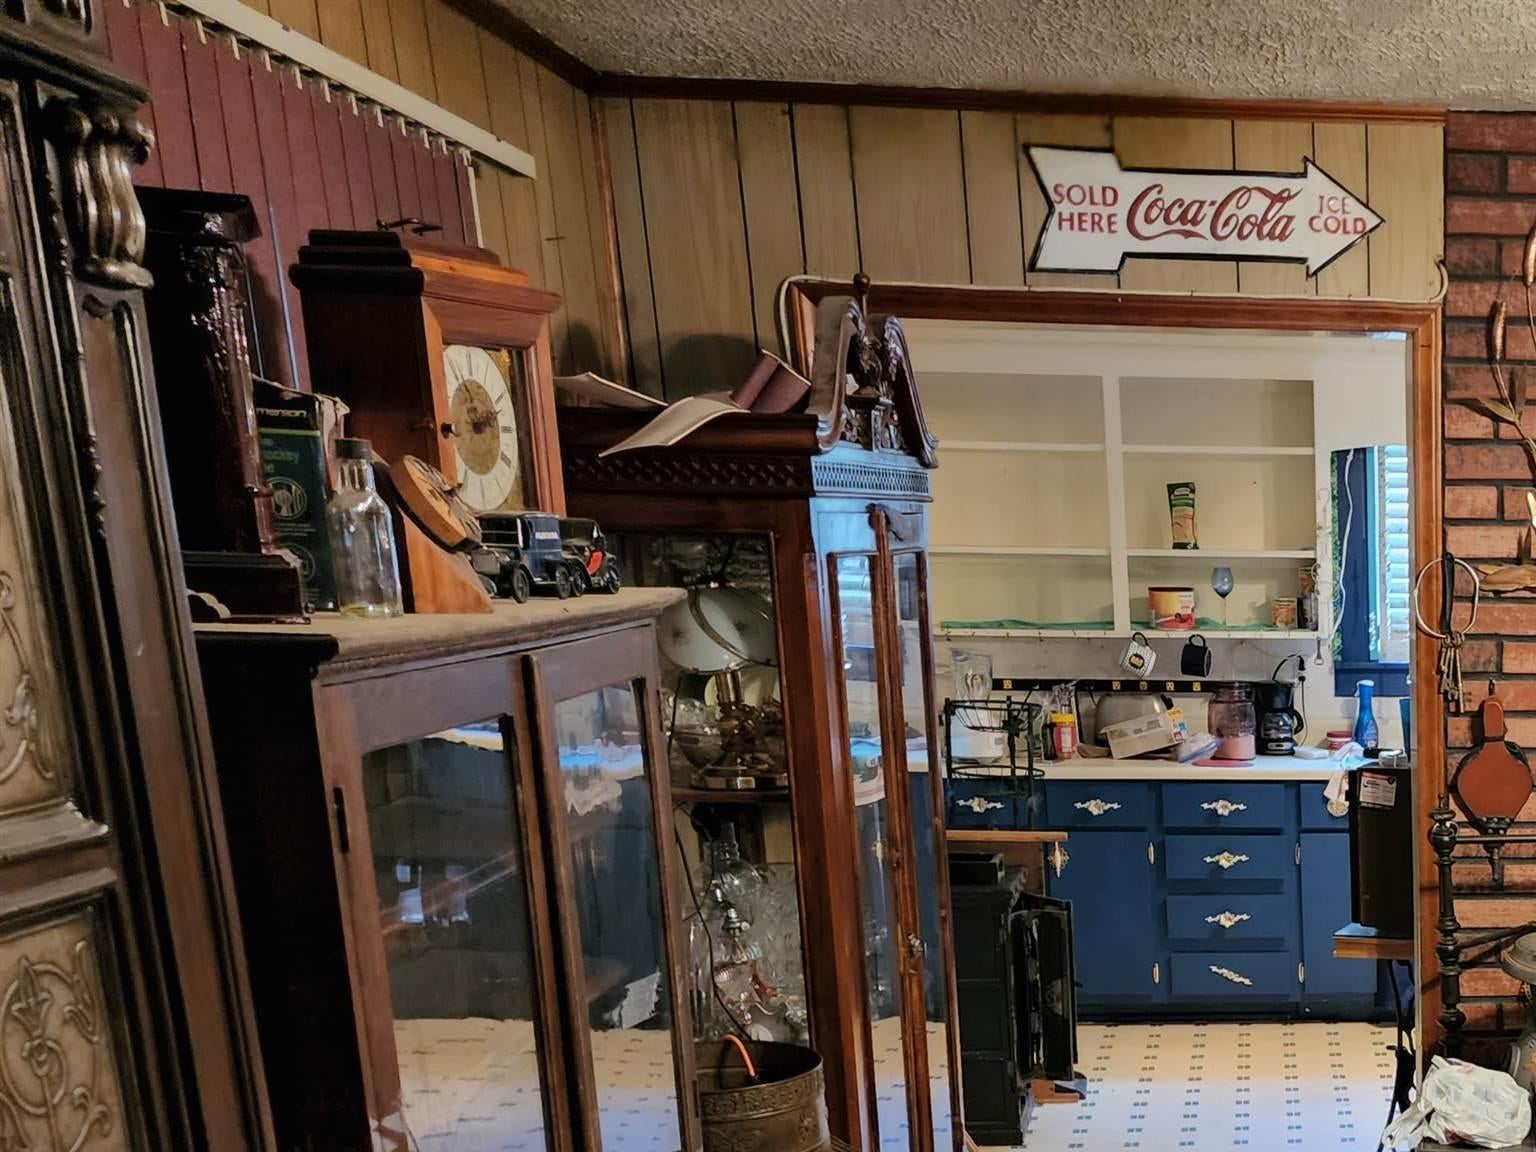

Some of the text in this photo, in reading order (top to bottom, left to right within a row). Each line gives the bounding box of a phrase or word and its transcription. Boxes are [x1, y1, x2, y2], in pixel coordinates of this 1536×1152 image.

[1053, 183, 1119, 208] SOLD
[1318, 194, 1349, 214] ICE
[1057, 211, 1118, 235] HERE
[1126, 182, 1303, 243] Coca-Cola
[1308, 216, 1367, 236] COLD
[256, 407, 307, 418] merson
